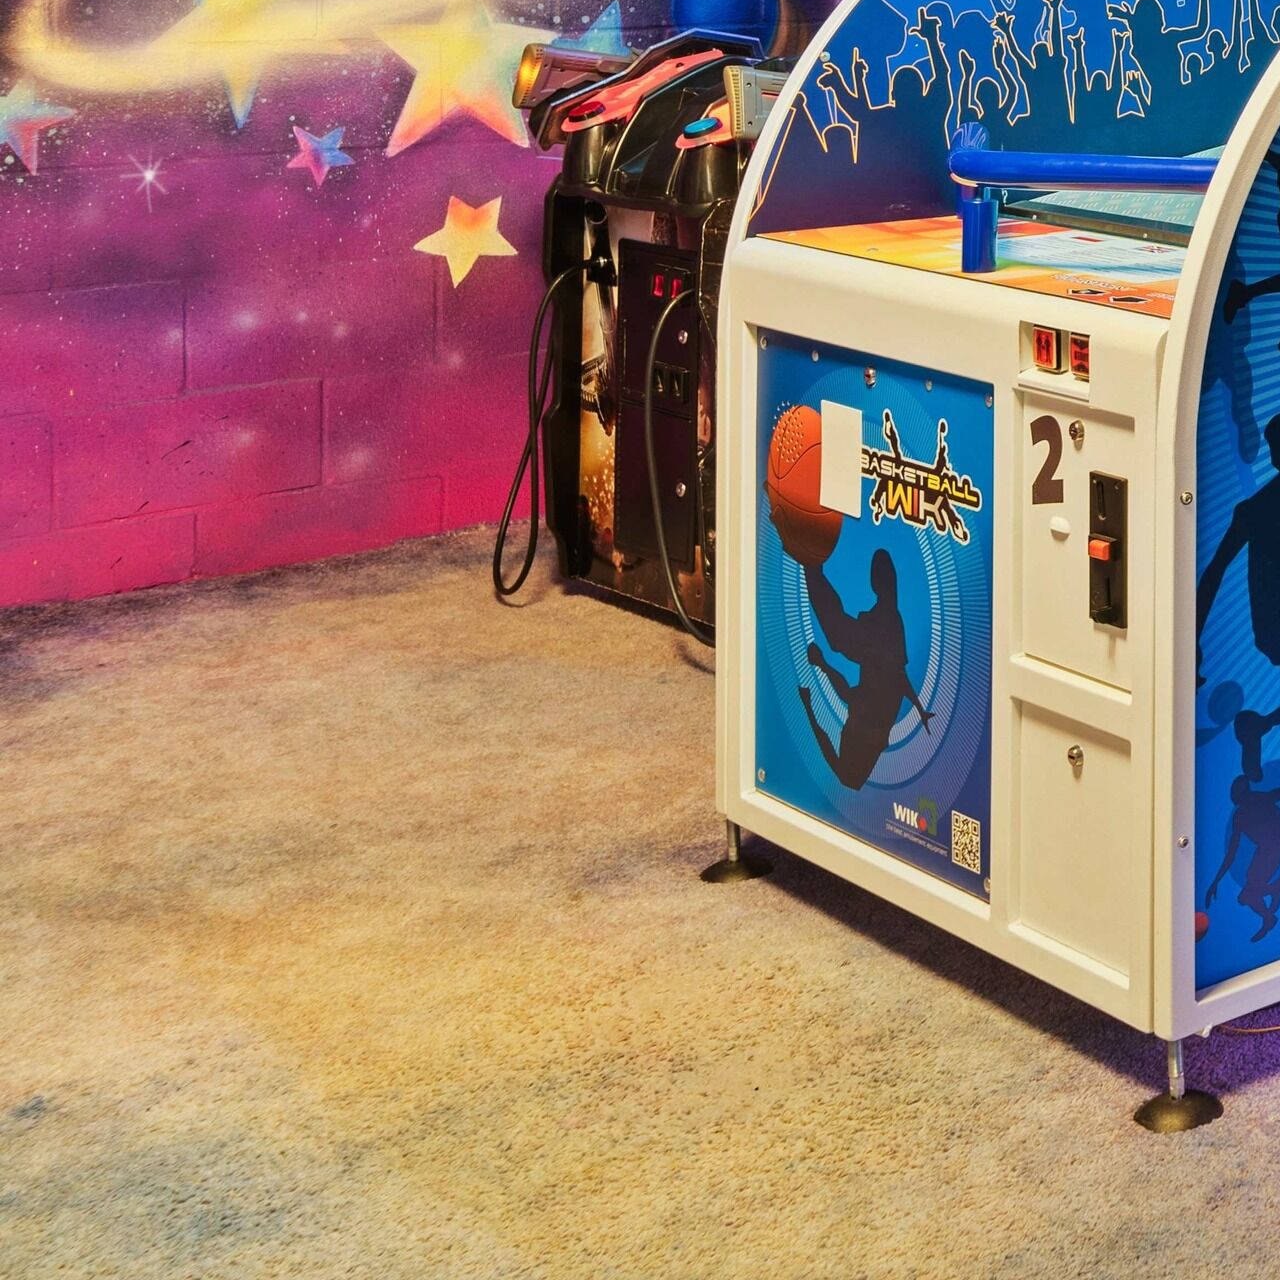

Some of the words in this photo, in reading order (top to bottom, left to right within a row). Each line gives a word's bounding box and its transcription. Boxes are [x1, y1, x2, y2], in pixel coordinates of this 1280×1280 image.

[861, 452, 978, 503] BASKETBALL
[1030, 414, 1064, 506] 2
[887, 480, 944, 528] WIK
[892, 801, 919, 829] WIK
